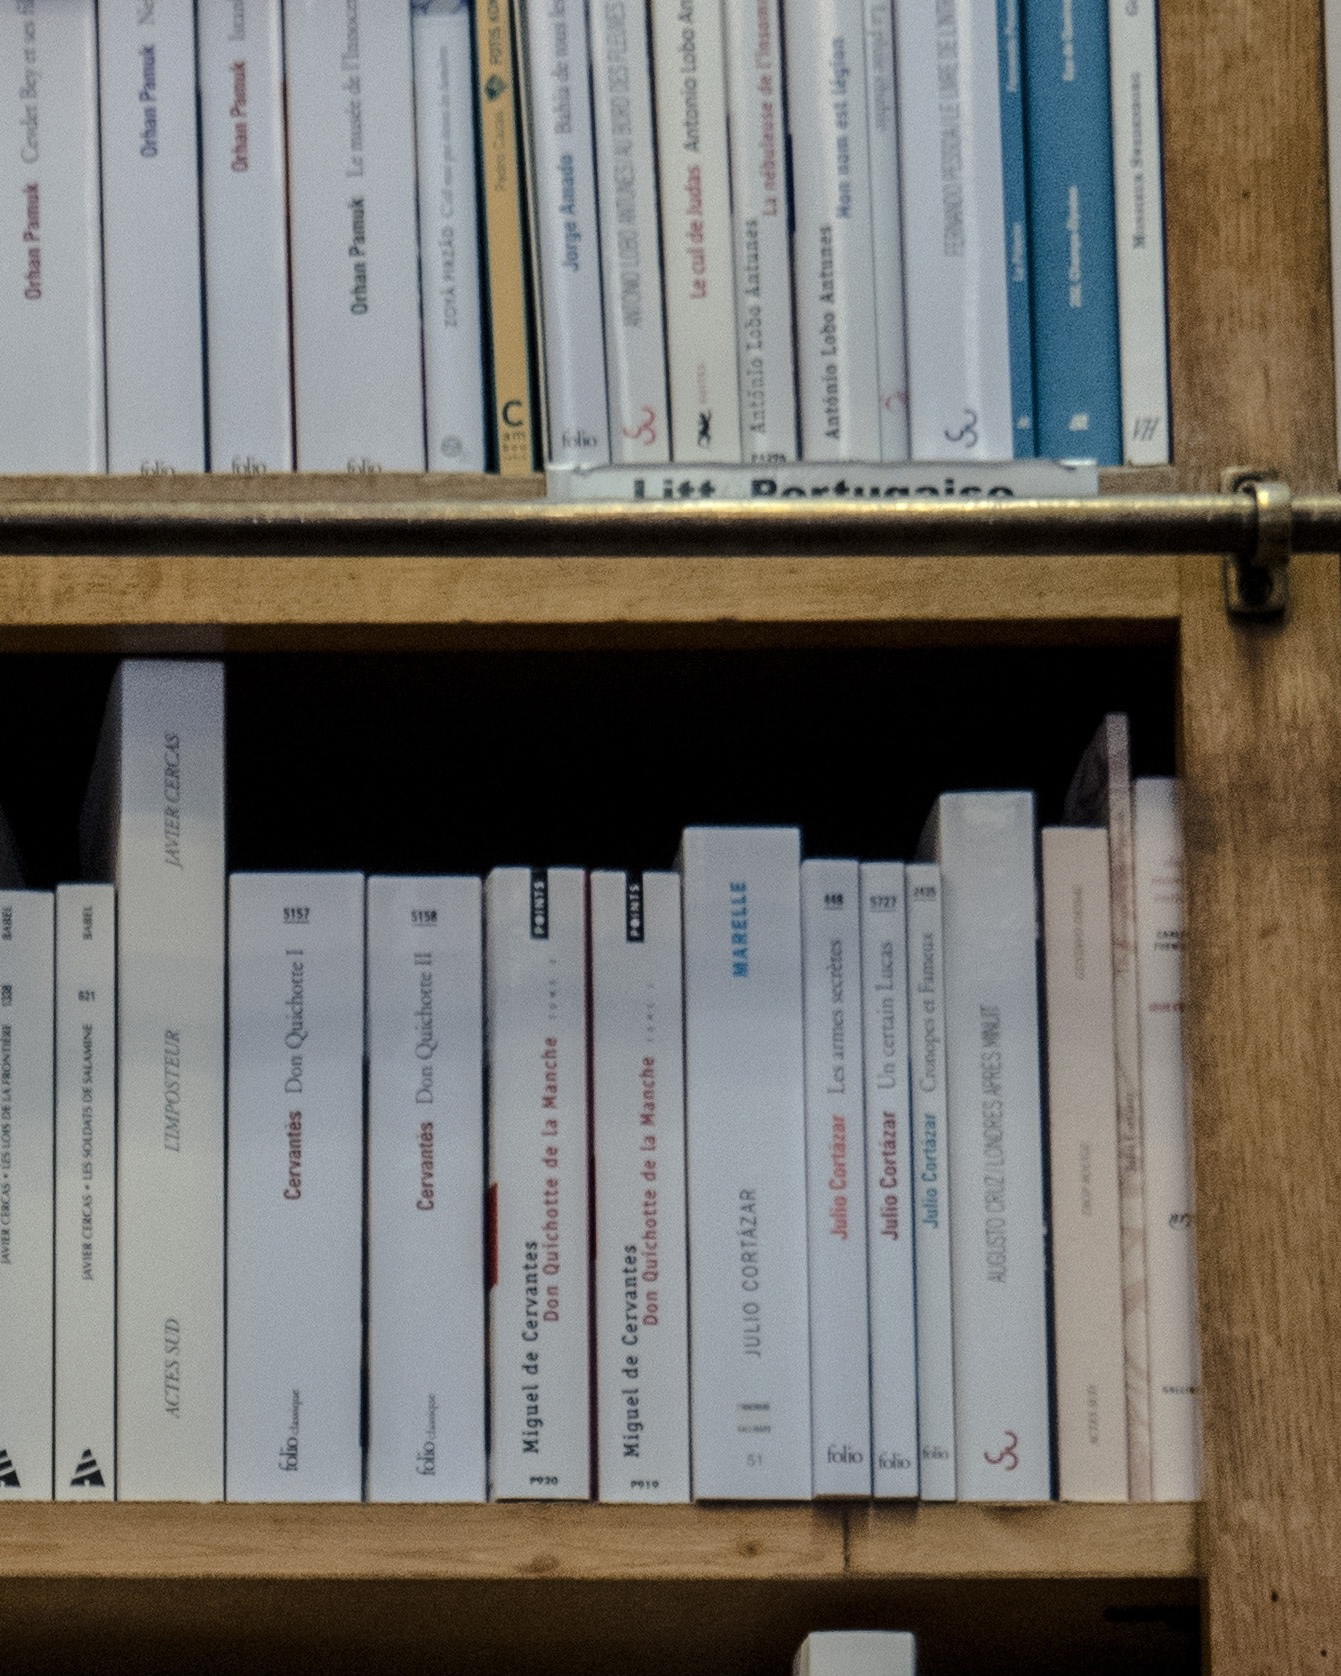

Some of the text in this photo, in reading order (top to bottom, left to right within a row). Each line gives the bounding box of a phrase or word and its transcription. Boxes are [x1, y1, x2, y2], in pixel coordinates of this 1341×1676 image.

[348, 197, 369, 315] Orhan Pamuk
[559, 153, 582, 272] Jorge Amado
[685, 165, 707, 299] Le cul de Judas
[730, 882, 749, 977] MARELLE
[541, 1037, 560, 1322] Don Quichotte de la Manche
[521, 1241, 544, 1453] Miguel de Cervantes
[742, 1302, 761, 1357] JULIO
